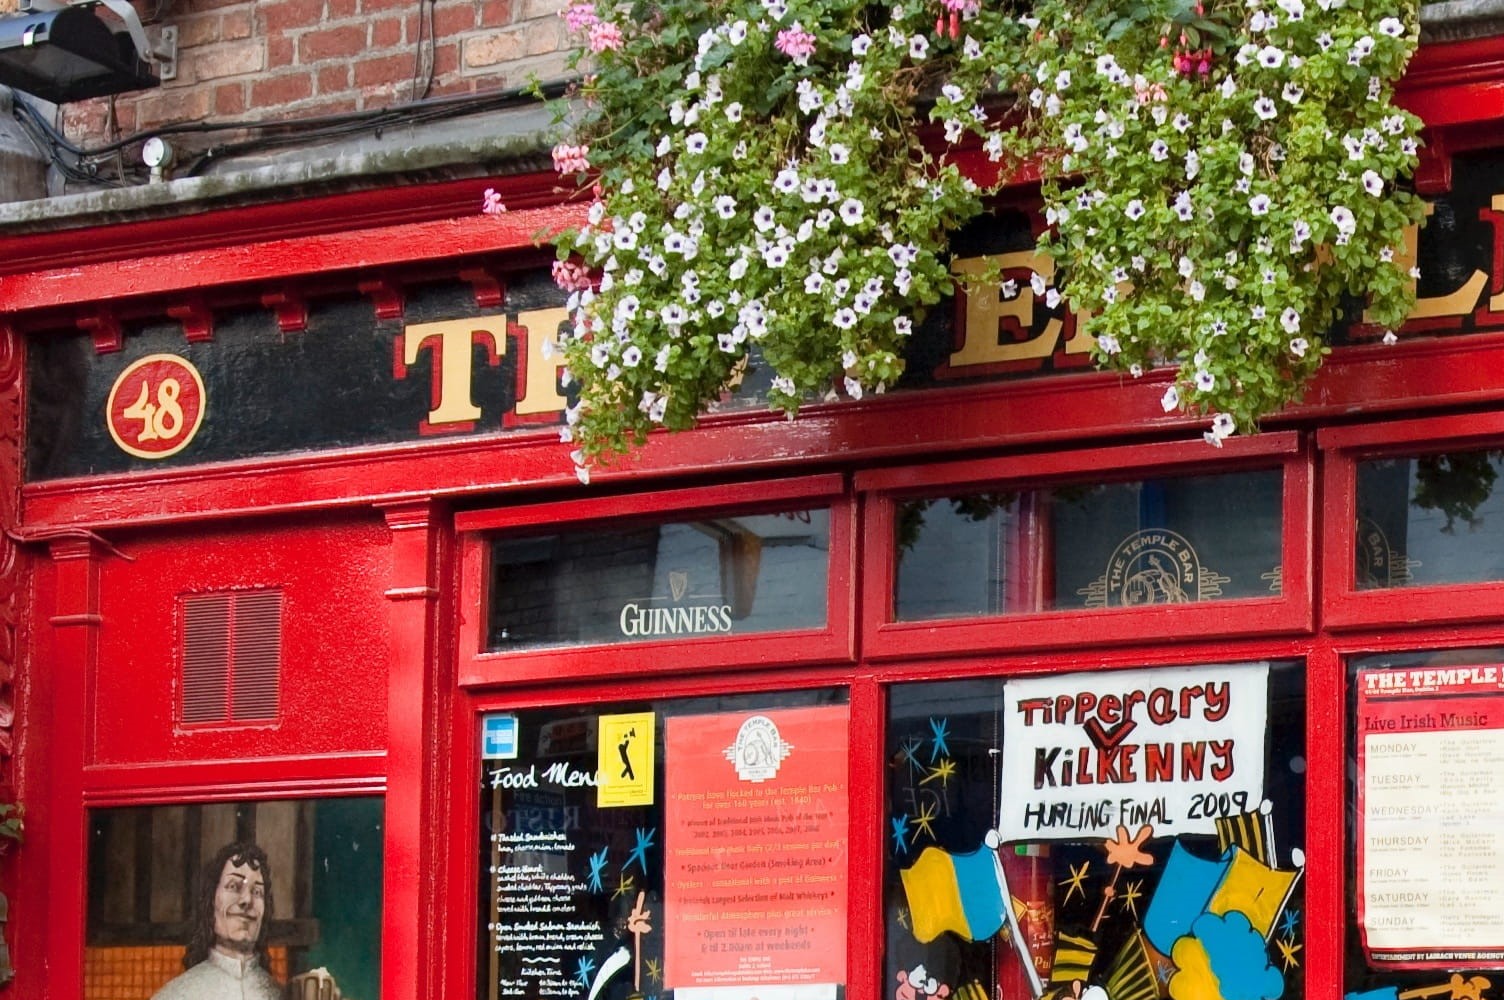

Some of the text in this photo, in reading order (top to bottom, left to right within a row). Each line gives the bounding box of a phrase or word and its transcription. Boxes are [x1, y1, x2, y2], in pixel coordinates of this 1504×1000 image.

[122, 378, 185, 444] 48
[1110, 534, 1195, 592] THE TEMPLE BAR
[620, 603, 732, 636] GUINNESS
[1364, 670, 1407, 690] THE
[1409, 667, 1498, 688] TEMPLE
[743, 719, 771, 733] TEMPLE
[1364, 711, 1488, 731] Live Irish Music
[1370, 743, 1417, 753] MONDAY
[489, 764, 538, 790] Food
[1371, 774, 1421, 785] TUESDAY
[1186, 790, 1251, 821] 2009
[1370, 806, 1440, 816] WEDNESDAY
[1370, 836, 1430, 847] THURSDAY
[768, 858, 804, 870] (Smoking
[805, 857, 826, 867] Area)
[1369, 868, 1409, 879] FRIDAY
[1370, 893, 1429, 903] SATURDAY
[566, 921, 601, 931] Sandwich
[1371, 917, 1416, 927] SUNDAY
[703, 929, 725, 939] Open
[758, 926, 782, 937] every
[785, 925, 809, 936] night
[767, 939, 811, 950] weekends
